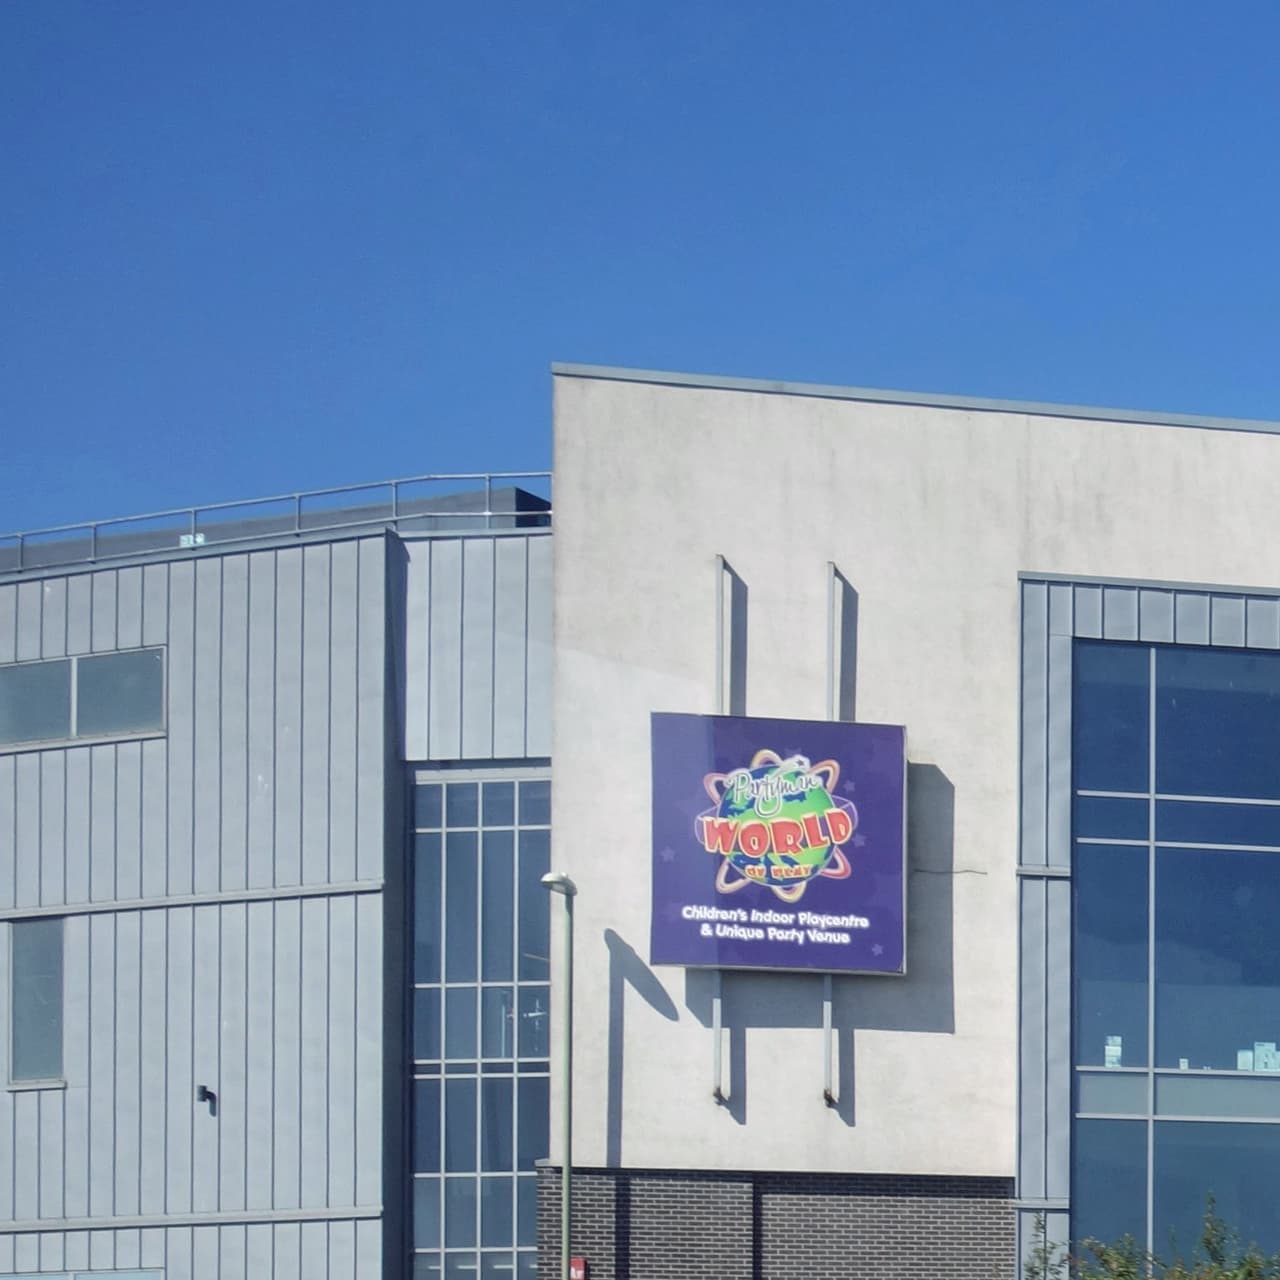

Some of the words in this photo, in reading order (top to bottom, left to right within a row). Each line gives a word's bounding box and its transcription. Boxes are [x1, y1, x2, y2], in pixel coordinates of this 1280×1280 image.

[726, 760, 822, 817] Partyman
[702, 809, 853, 857] WORLD
[682, 905, 748, 921] Children's
[750, 908, 795, 925] Indoor
[798, 911, 869, 928] Playcentre
[700, 925, 713, 937] &
[715, 925, 764, 941] Unique
[768, 928, 804, 945] Party
[808, 930, 851, 944] Venue
